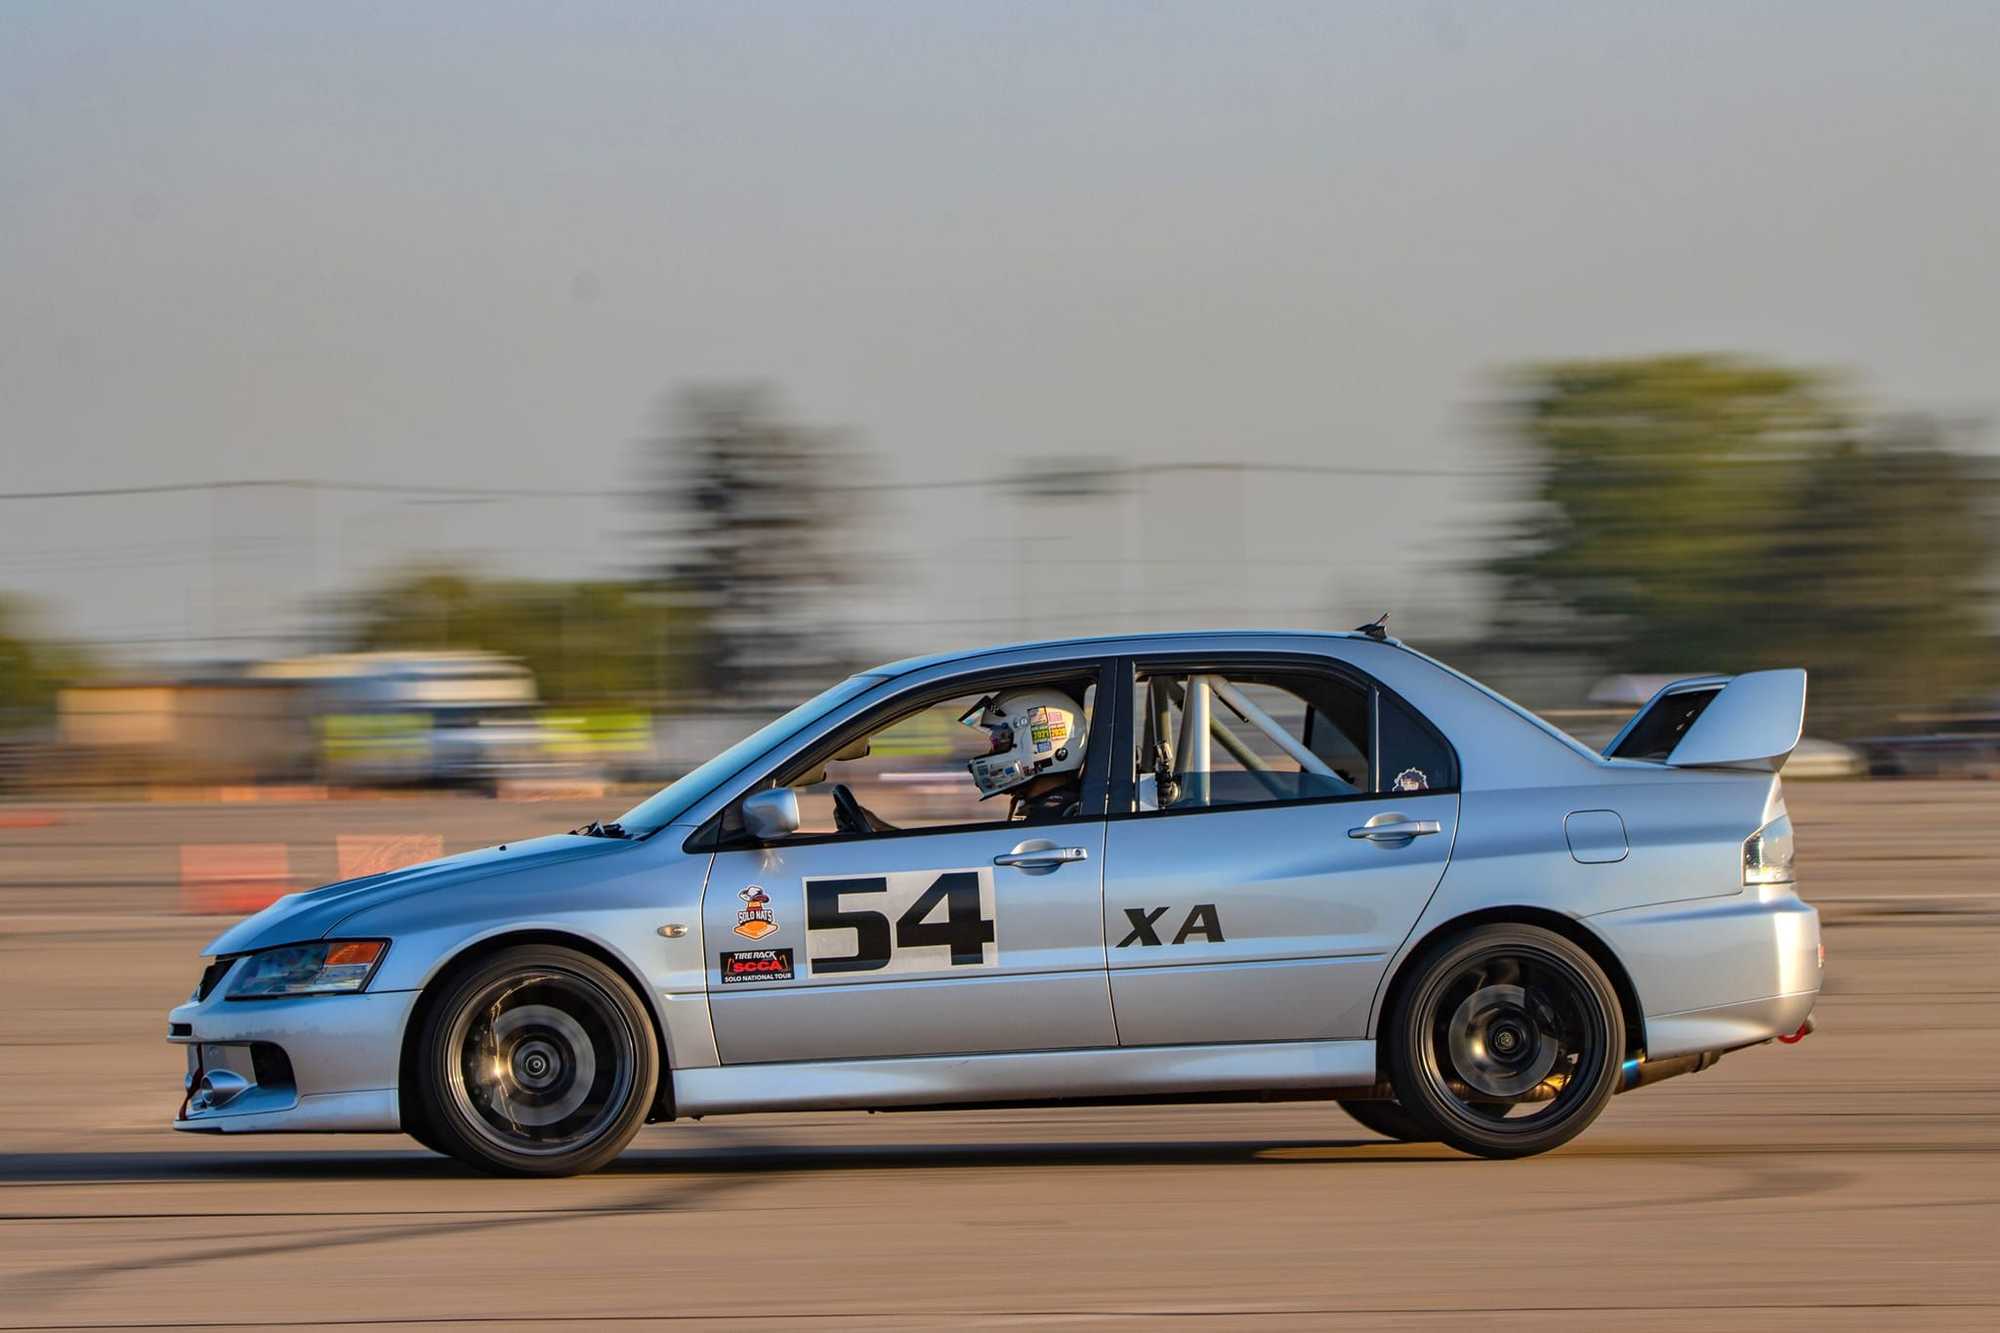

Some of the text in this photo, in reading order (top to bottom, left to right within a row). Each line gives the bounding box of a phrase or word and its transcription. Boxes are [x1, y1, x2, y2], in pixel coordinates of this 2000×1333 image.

[738, 910, 773, 922] SOLO NATS
[806, 871, 995, 974] 54
[1115, 904, 1226, 948] XA
[734, 951, 777, 960] TIRE RACK
[733, 960, 782, 973] SCCA
[743, 974, 774, 982] NATIONAL
